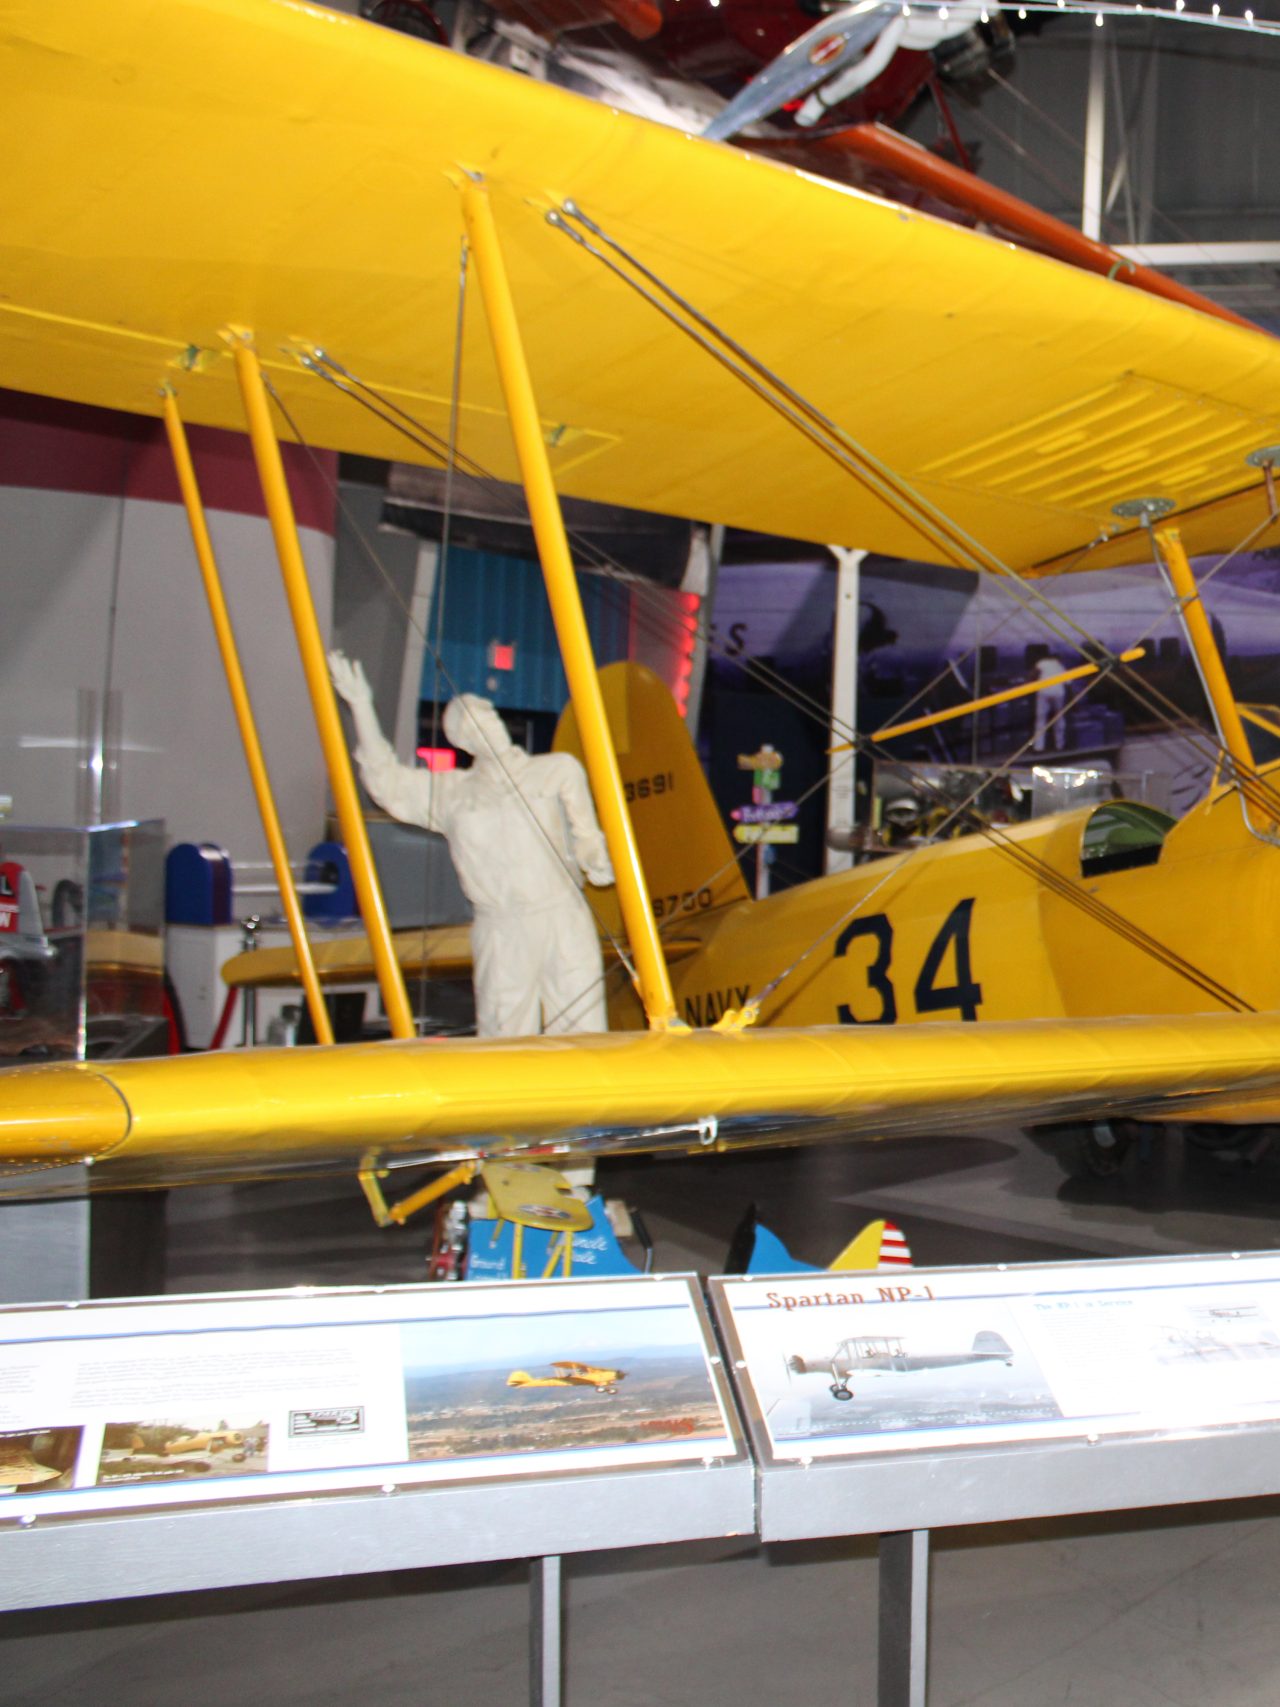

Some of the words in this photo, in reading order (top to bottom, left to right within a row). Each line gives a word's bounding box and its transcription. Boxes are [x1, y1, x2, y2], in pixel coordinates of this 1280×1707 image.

[834, 898, 982, 1025] 34
[685, 985, 749, 1028] NAVY
[766, 1291, 864, 1311] Spartan
[876, 1285, 936, 1303] NP-1
